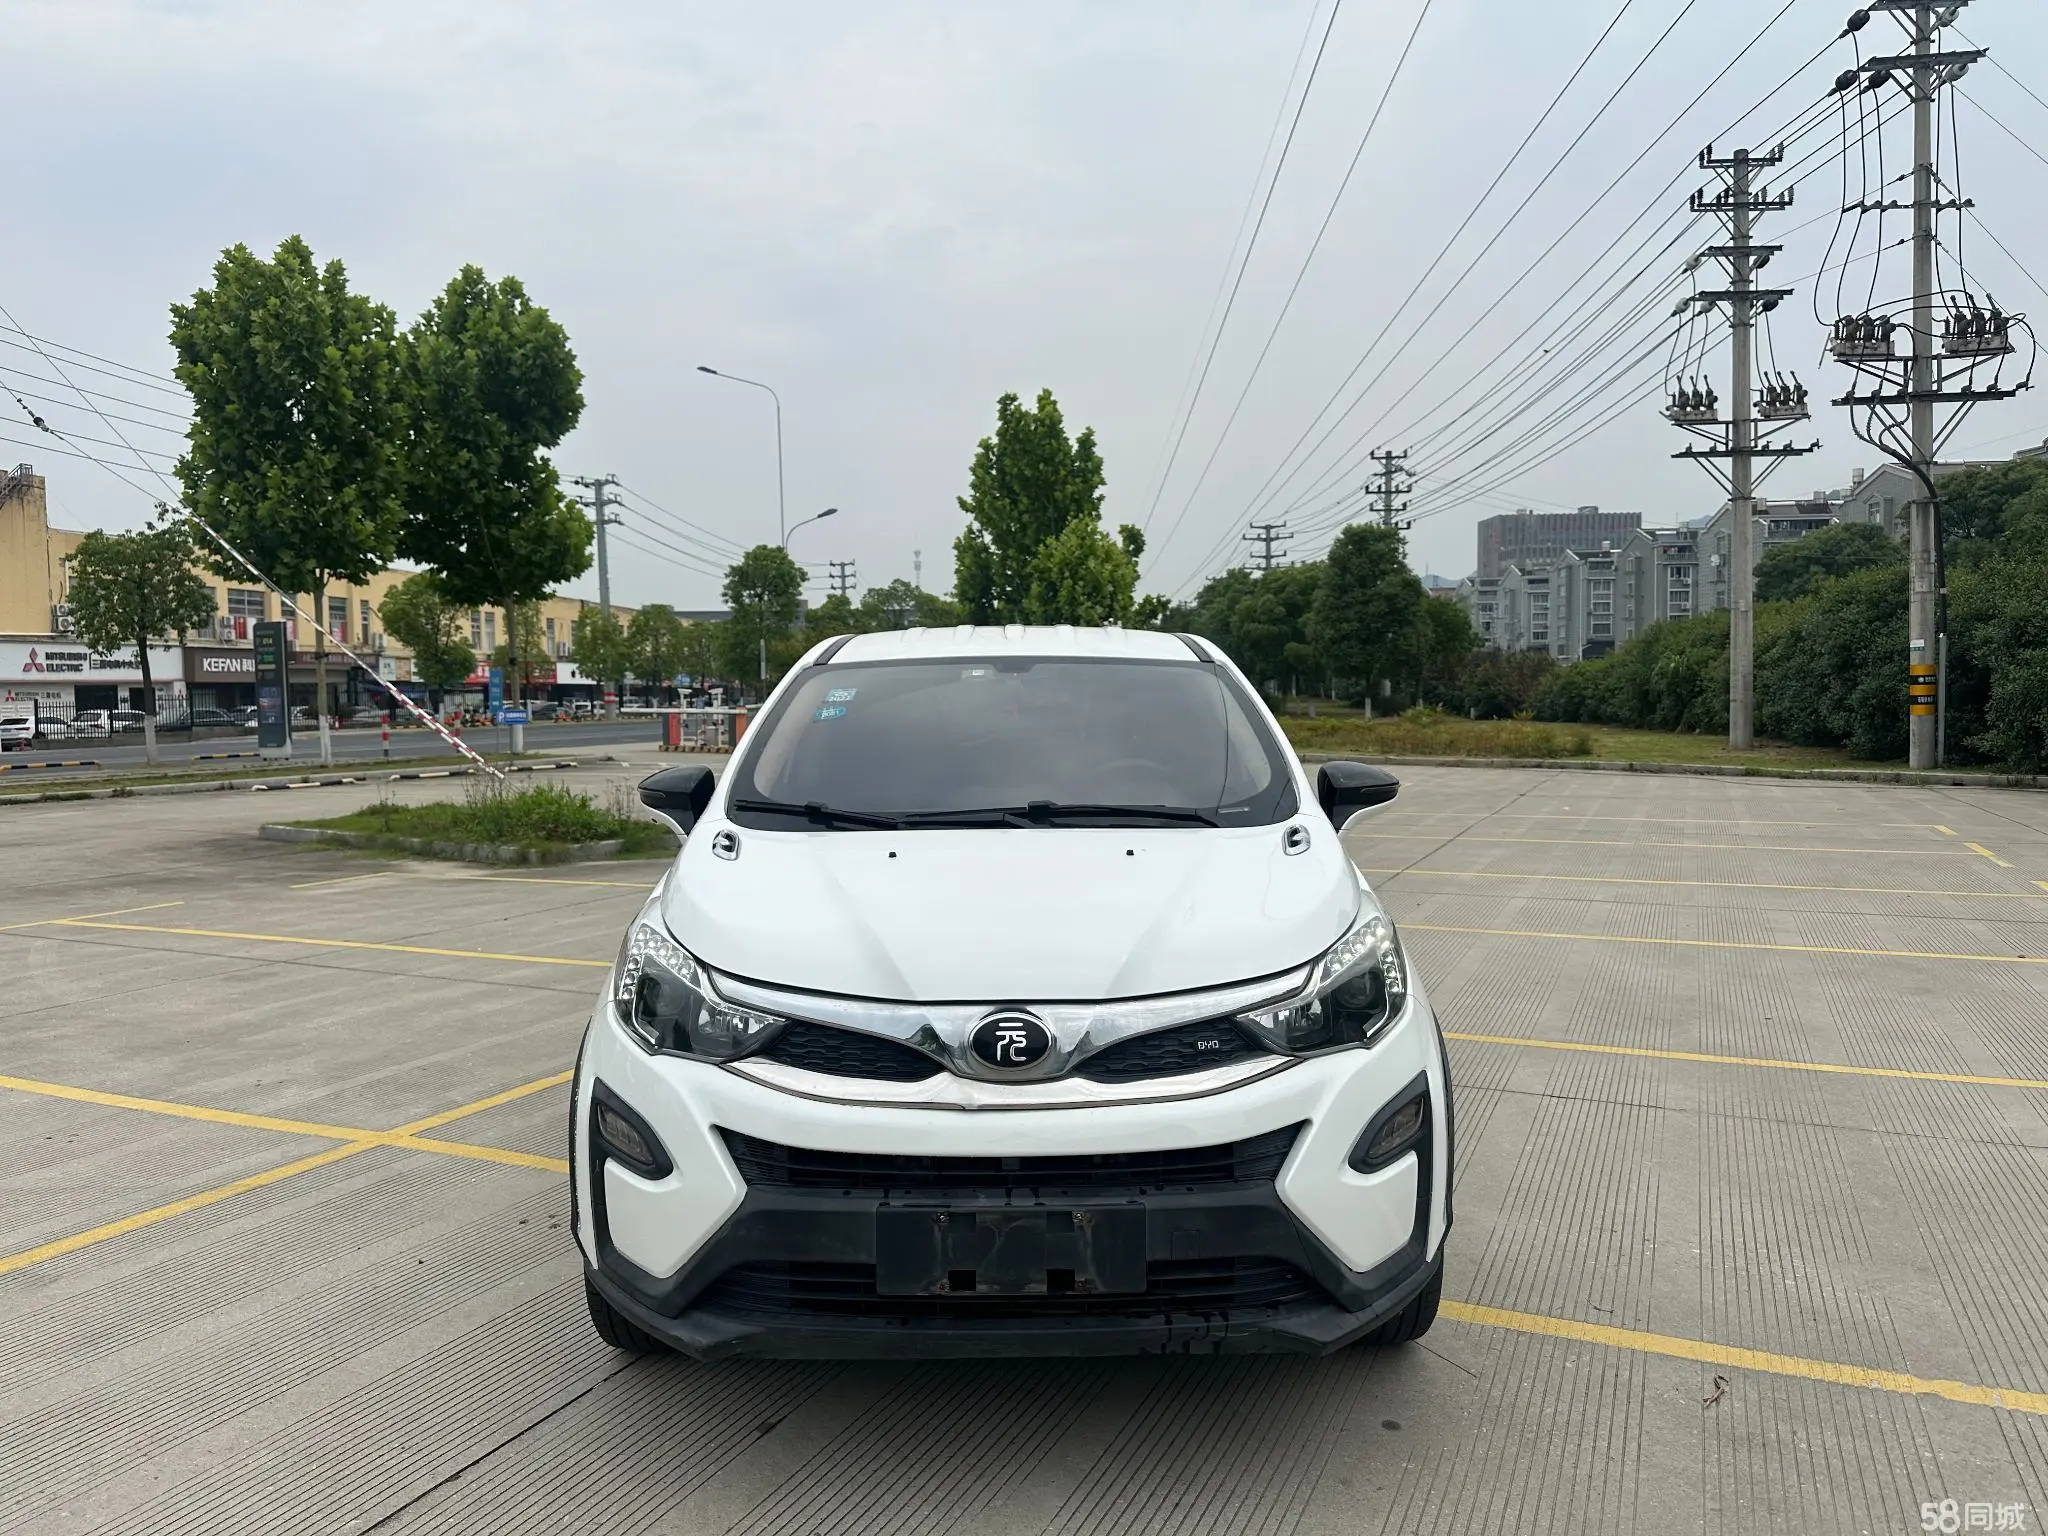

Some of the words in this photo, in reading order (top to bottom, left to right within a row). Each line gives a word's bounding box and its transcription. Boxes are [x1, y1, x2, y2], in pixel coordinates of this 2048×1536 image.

[46, 663, 84, 673] ELECTRIC
[203, 658, 241, 672] KEFAN
[1197, 1040, 1219, 1050] BYD
